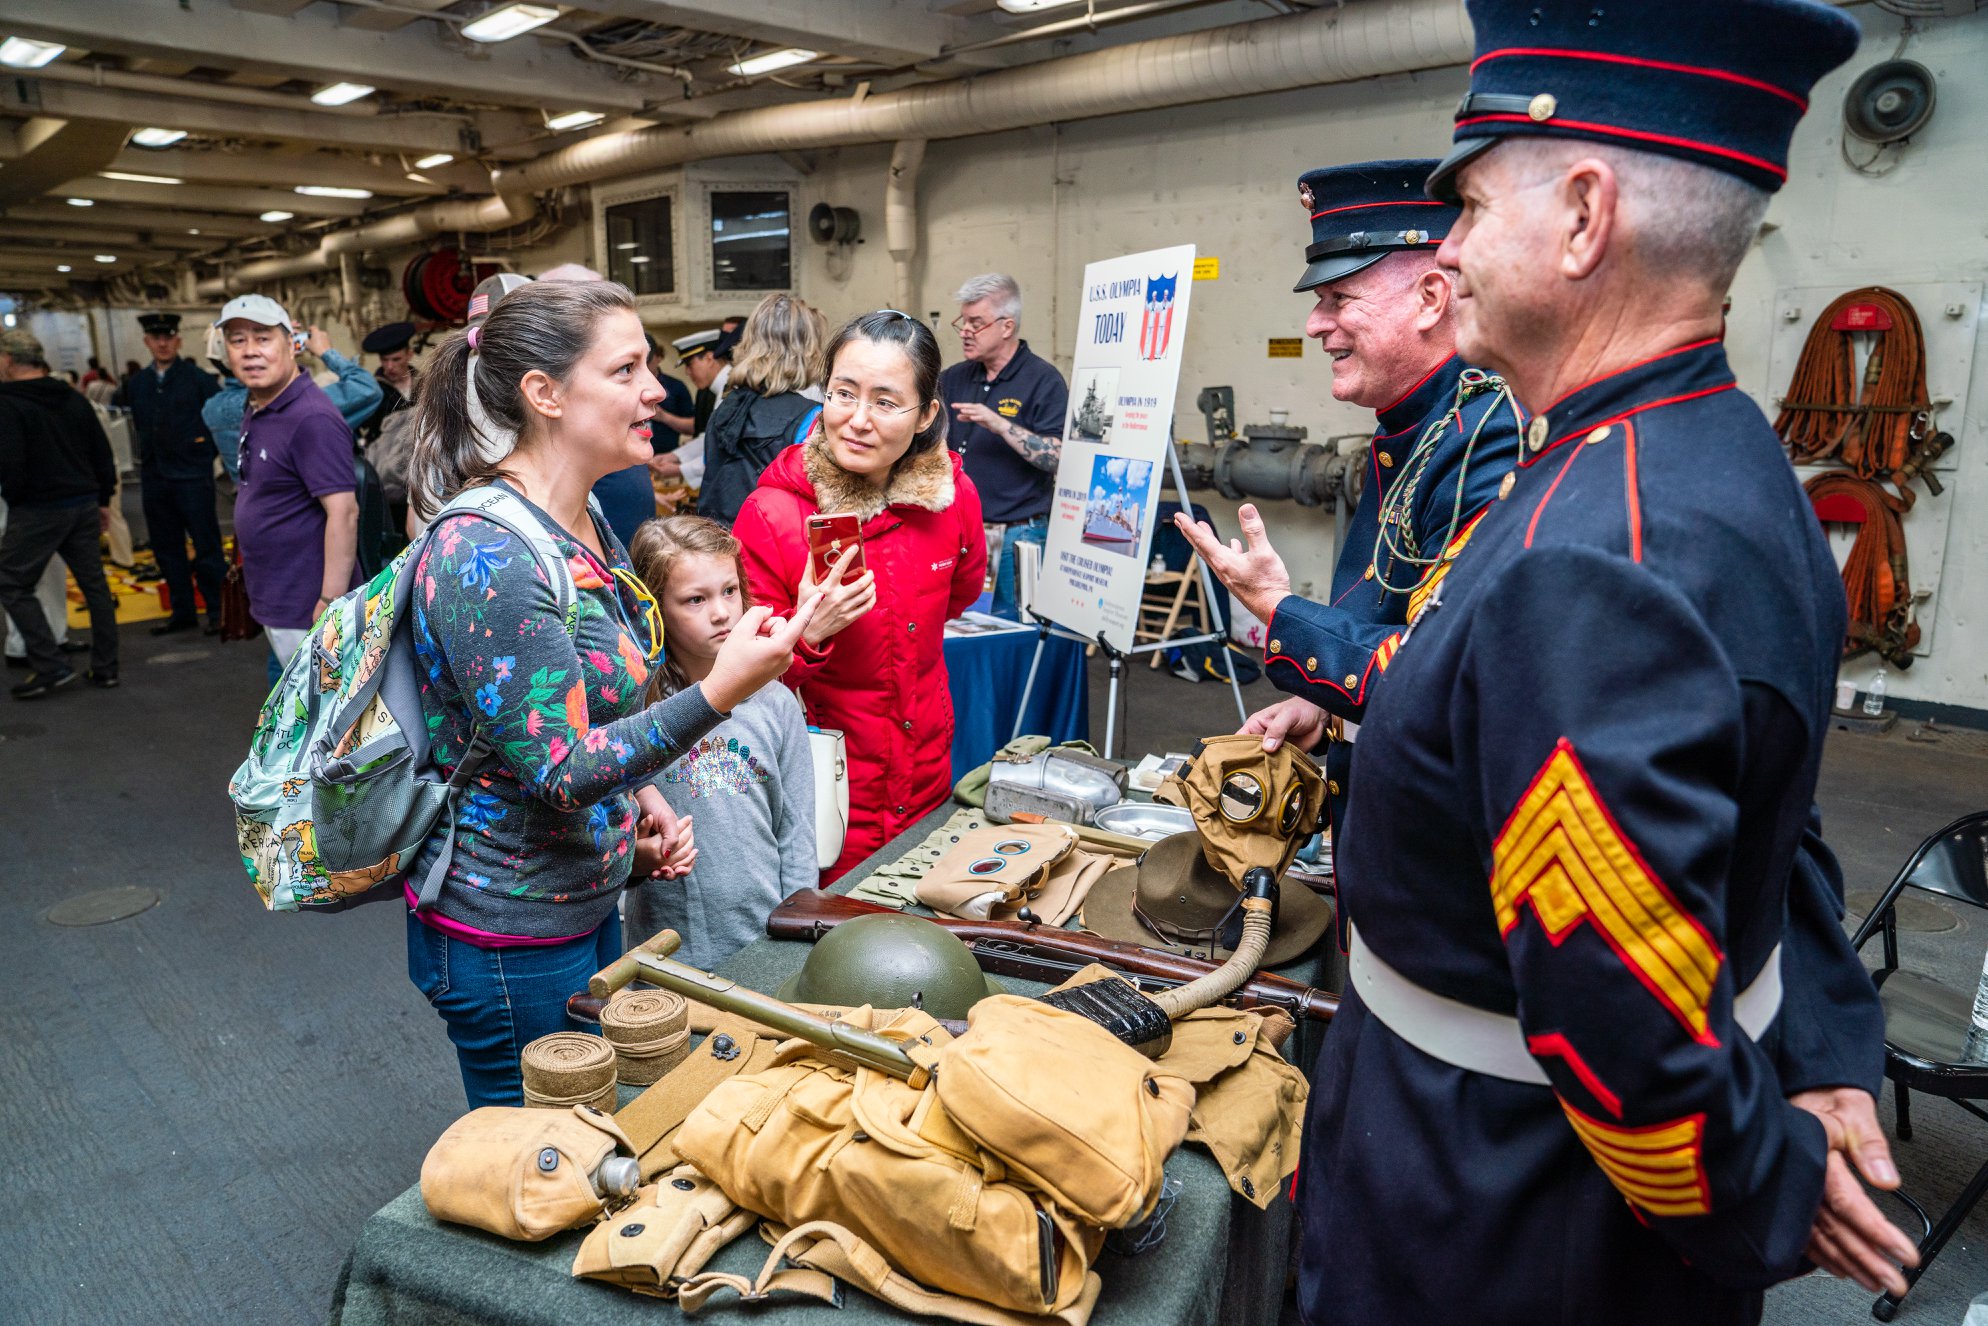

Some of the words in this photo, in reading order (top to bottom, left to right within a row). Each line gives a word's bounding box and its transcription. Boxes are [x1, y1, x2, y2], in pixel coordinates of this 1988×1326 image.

[1089, 284, 1107, 303] U.S.S.
[1109, 278, 1141, 299] OLYMPIA
[1093, 312, 1127, 344] TODAY
[1144, 396, 1157, 408] 1919
